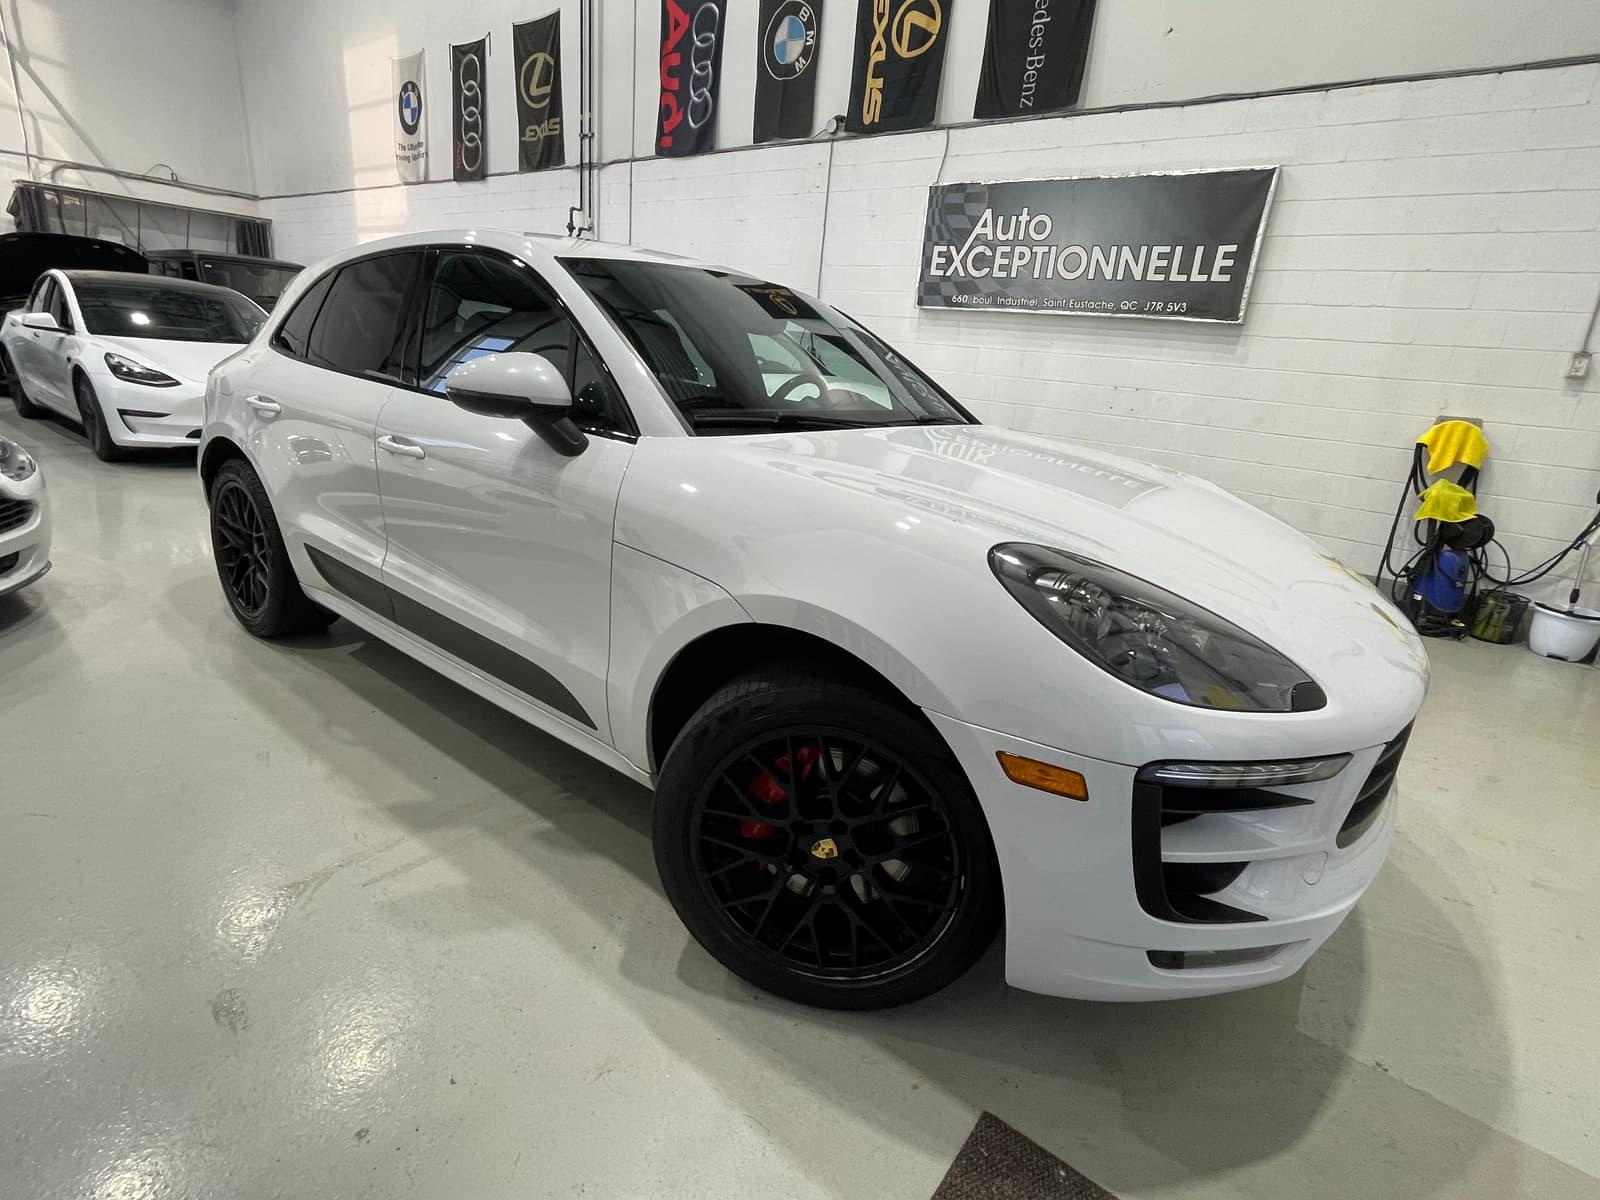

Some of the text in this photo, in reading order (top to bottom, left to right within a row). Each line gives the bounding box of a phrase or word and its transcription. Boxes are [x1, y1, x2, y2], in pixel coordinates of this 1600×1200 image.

[794, 6, 816, 73] BMW
[966, 207, 1052, 246] Auto
[930, 244, 1238, 281] EXCEPTIONNELLE
[1121, 300, 1138, 310] QC
[1144, 301, 1164, 311] J7R
[1167, 302, 1187, 312] 5V3
